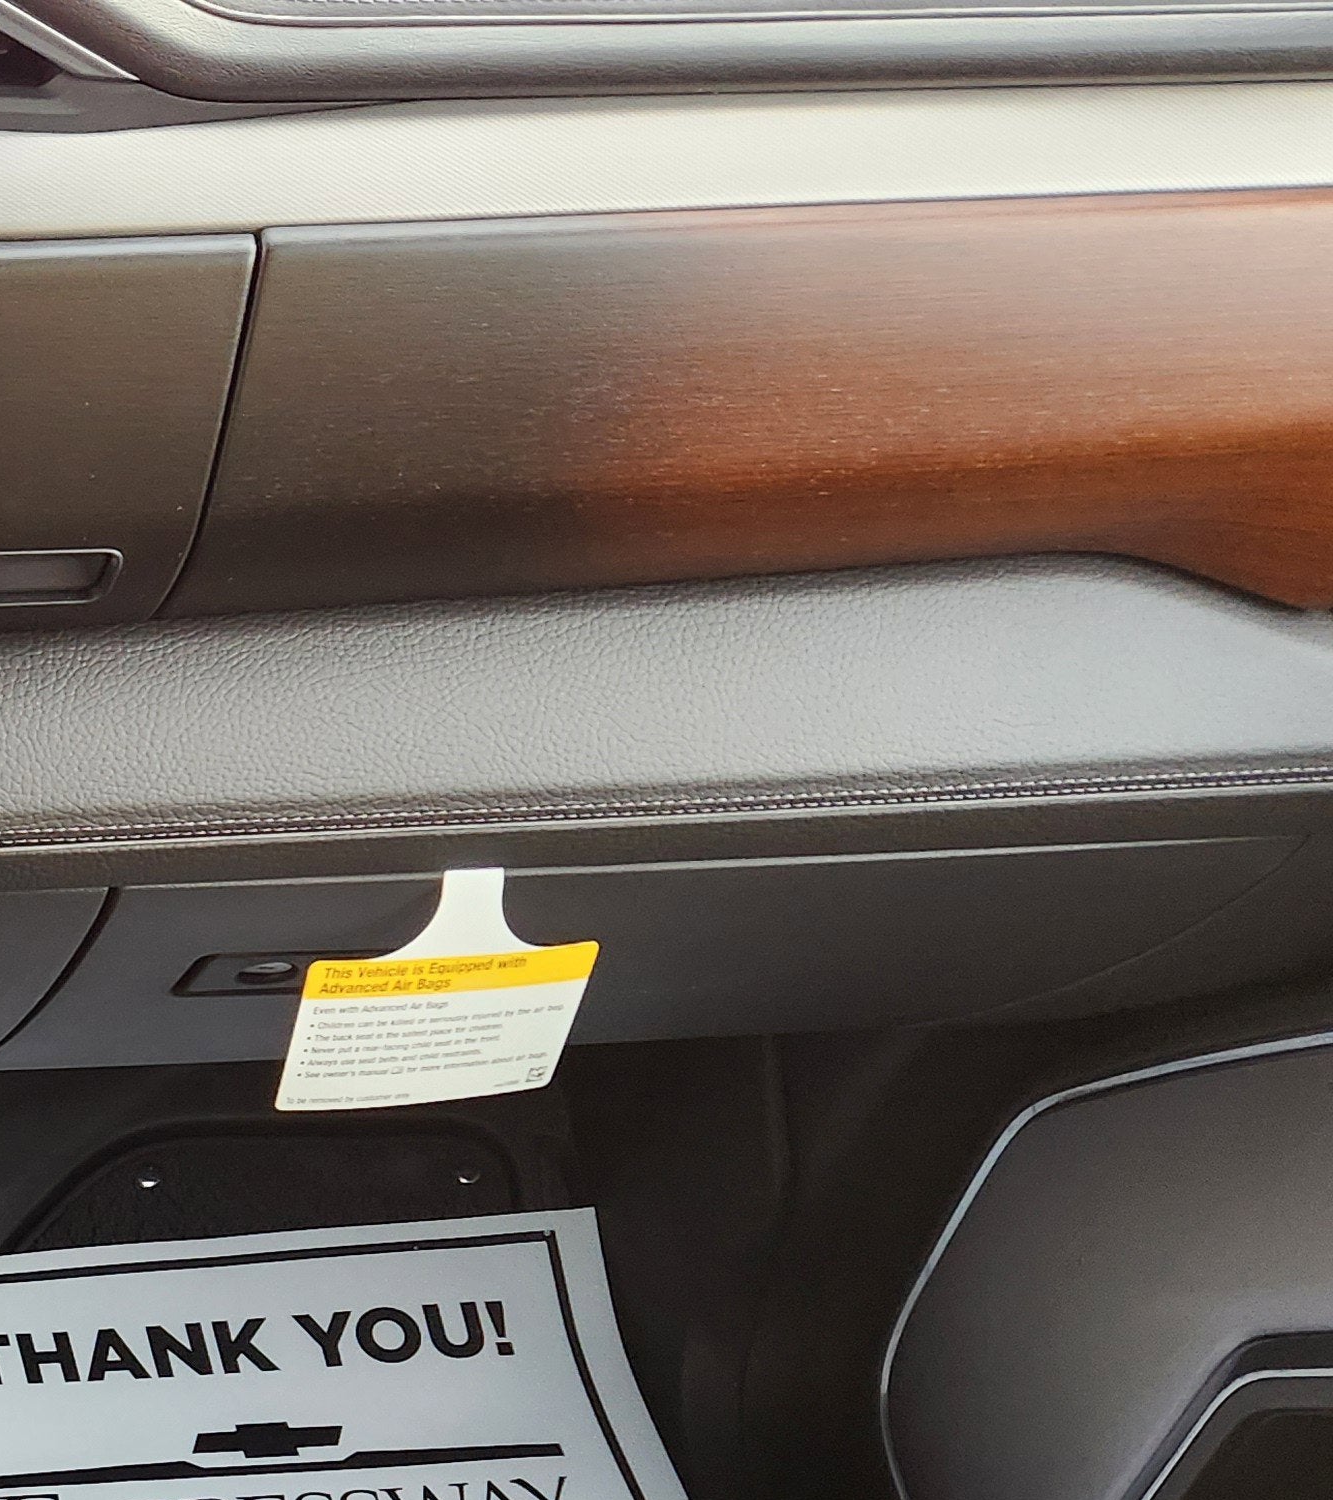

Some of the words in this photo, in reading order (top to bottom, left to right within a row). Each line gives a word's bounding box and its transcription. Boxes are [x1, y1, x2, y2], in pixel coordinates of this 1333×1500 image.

[325, 966, 353, 979] This
[358, 964, 410, 979] Vehicle
[412, 964, 425, 976] is
[429, 958, 494, 976] Equipped
[498, 956, 528, 969] with
[319, 980, 390, 995] Advanced
[392, 980, 414, 992] Air
[417, 978, 452, 992] Bags
[293, 1299, 515, 1366] YOU!
